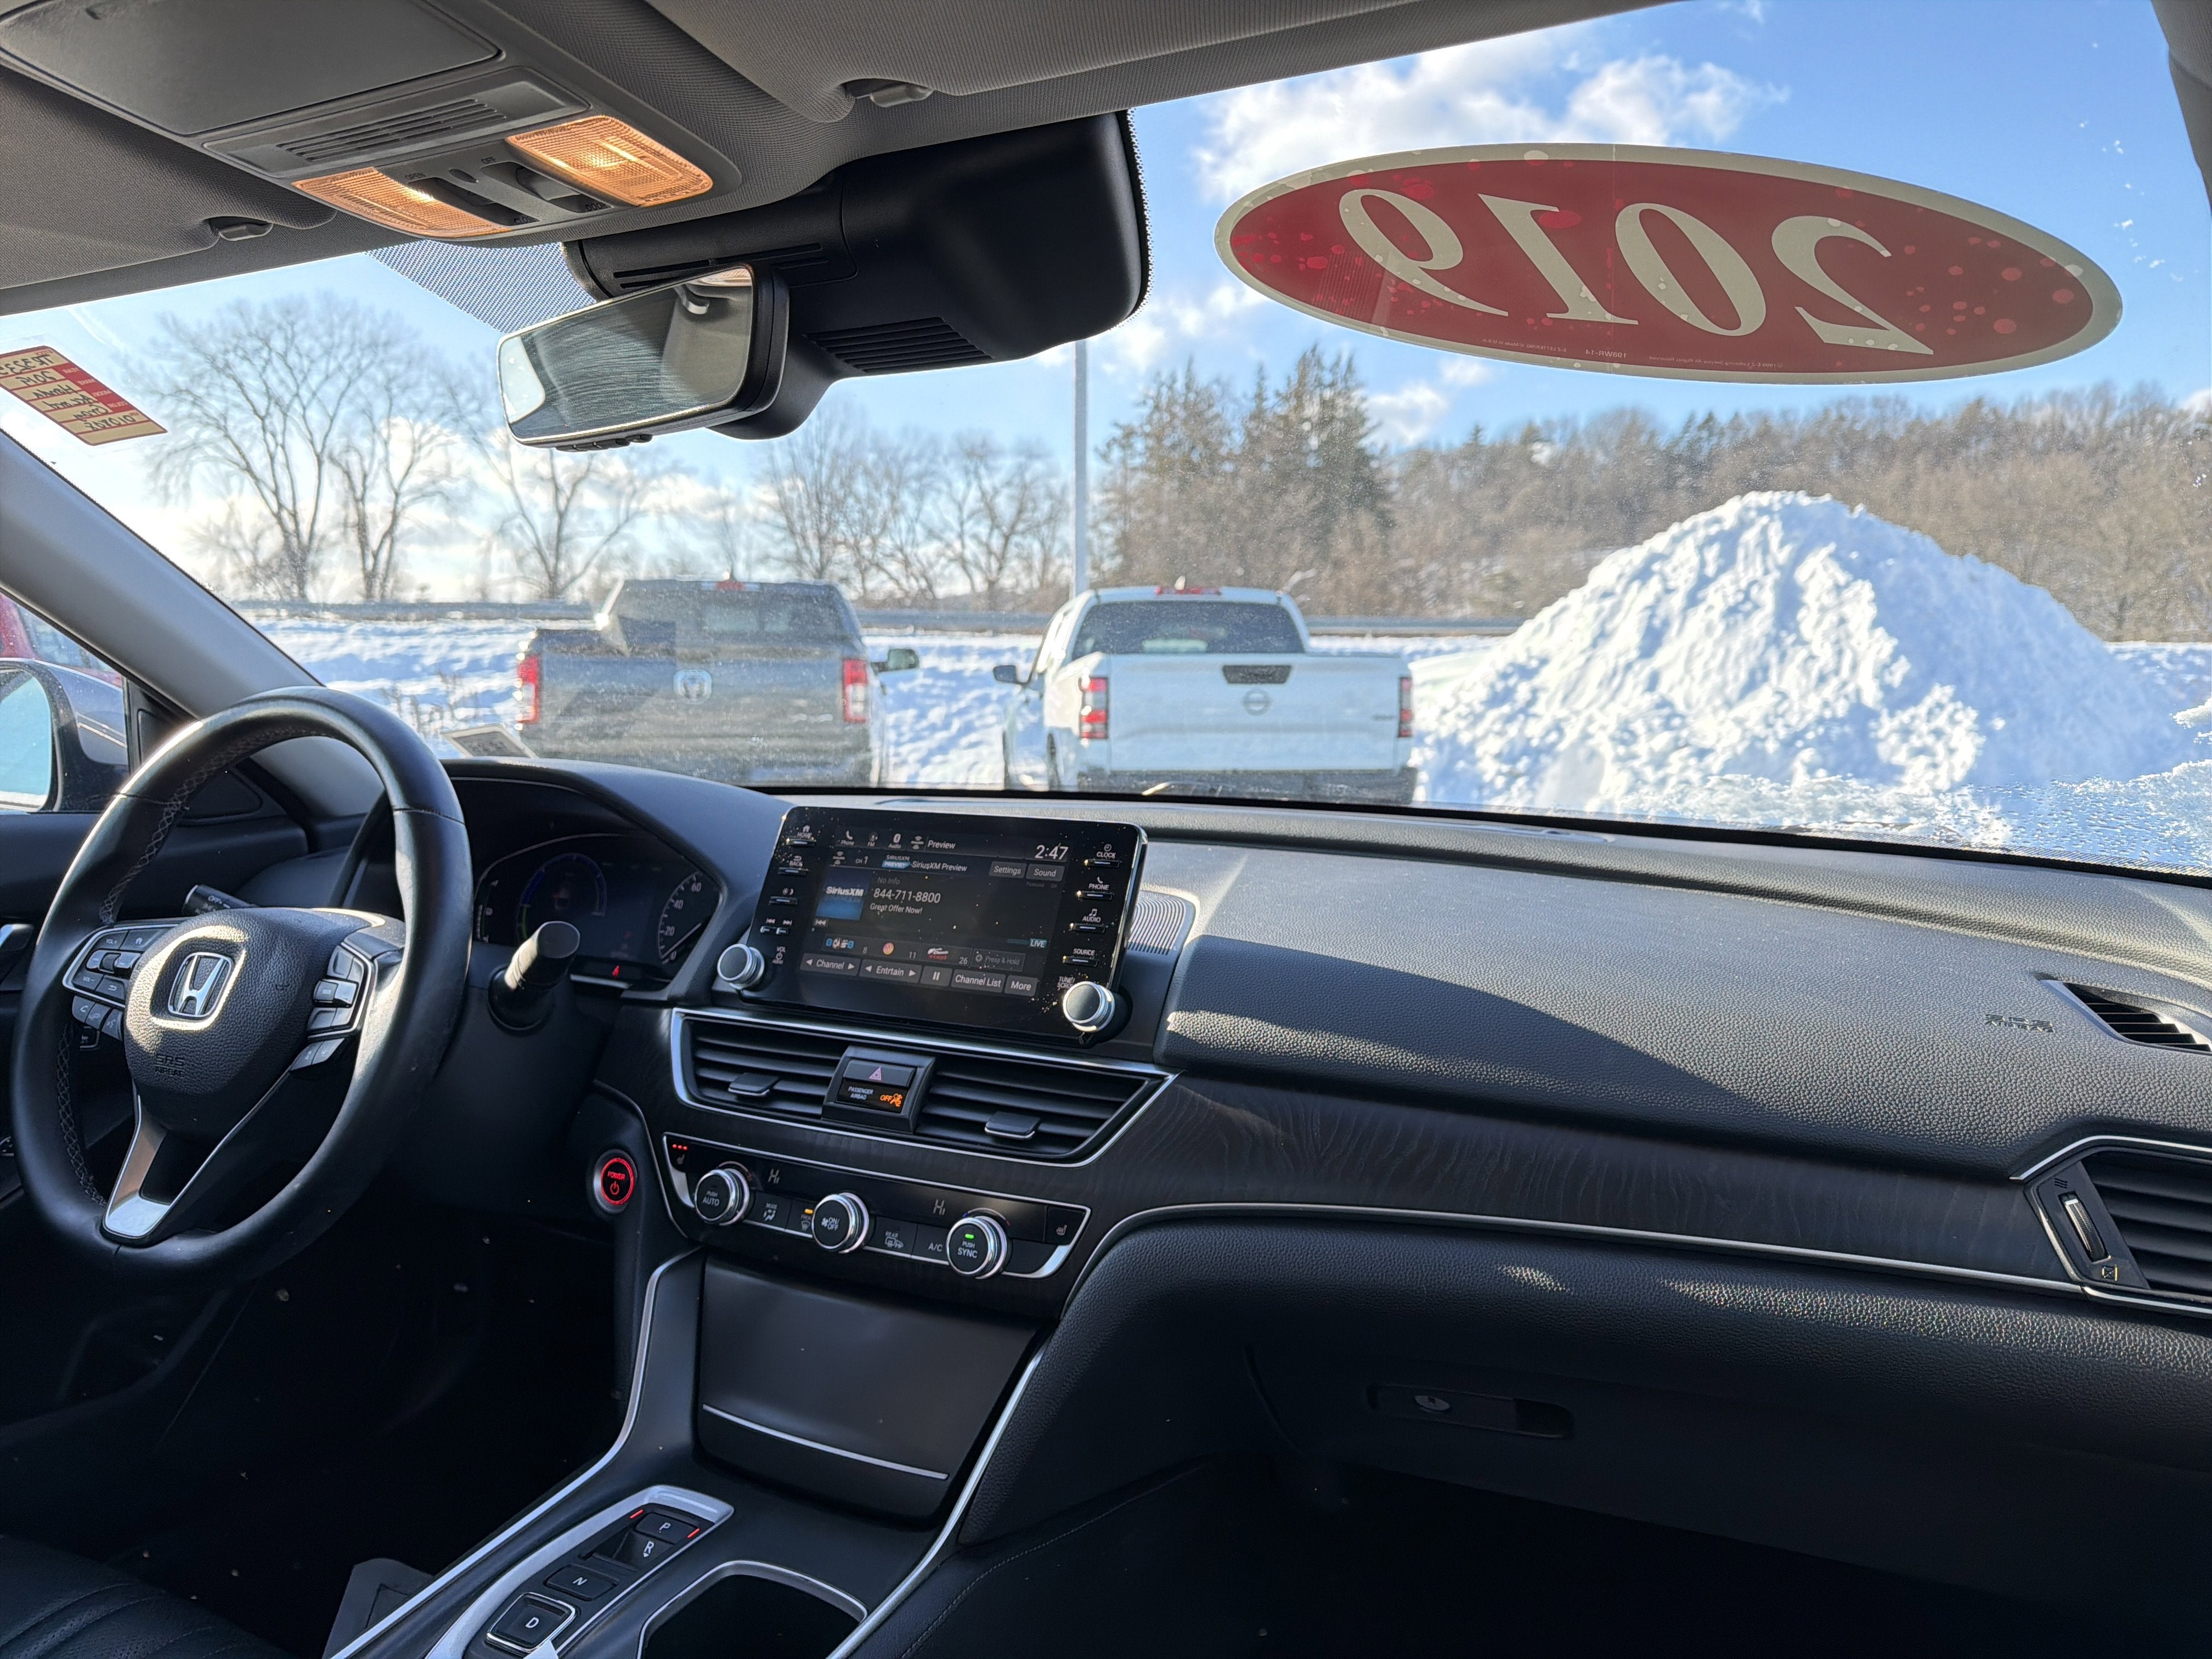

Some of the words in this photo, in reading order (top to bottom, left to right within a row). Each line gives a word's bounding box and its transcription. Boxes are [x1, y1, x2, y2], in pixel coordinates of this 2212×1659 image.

[927, 840, 956, 849] Preview
[1035, 844, 1069, 860] 2:47
[911, 861, 940, 870] SiriusXM
[941, 862, 968, 872] Preview
[994, 865, 1022, 876] Settings
[1034, 868, 1057, 877] Sound
[888, 877, 900, 885] Info
[691, 882, 702, 893] 60
[826, 886, 864, 897] SiriusXM
[873, 888, 941, 904] 844-711-8800
[674, 899, 684, 910] 40
[870, 902, 887, 912] Great
[888, 904, 905, 912] Offer
[1030, 939, 1046, 947] LIVE
[909, 951, 916, 960] 11
[985, 956, 999, 964] Press
[816, 960, 845, 970] Channel
[876, 966, 904, 977] Entrtain
[955, 974, 985, 986] Channel
[986, 977, 1002, 988] List
[1011, 981, 1032, 991] More
[848, 1086, 874, 1095] PASSENGER
[607, 1171, 625, 1180] POWER
[703, 1198, 719, 1206] AUTO
[928, 1242, 943, 1252] A/C
[958, 1248, 978, 1259] SYNC
[659, 1522, 671, 1531] P
[644, 1541, 654, 1554] R
[573, 1577, 588, 1585] N
[526, 1617, 539, 1628] D
